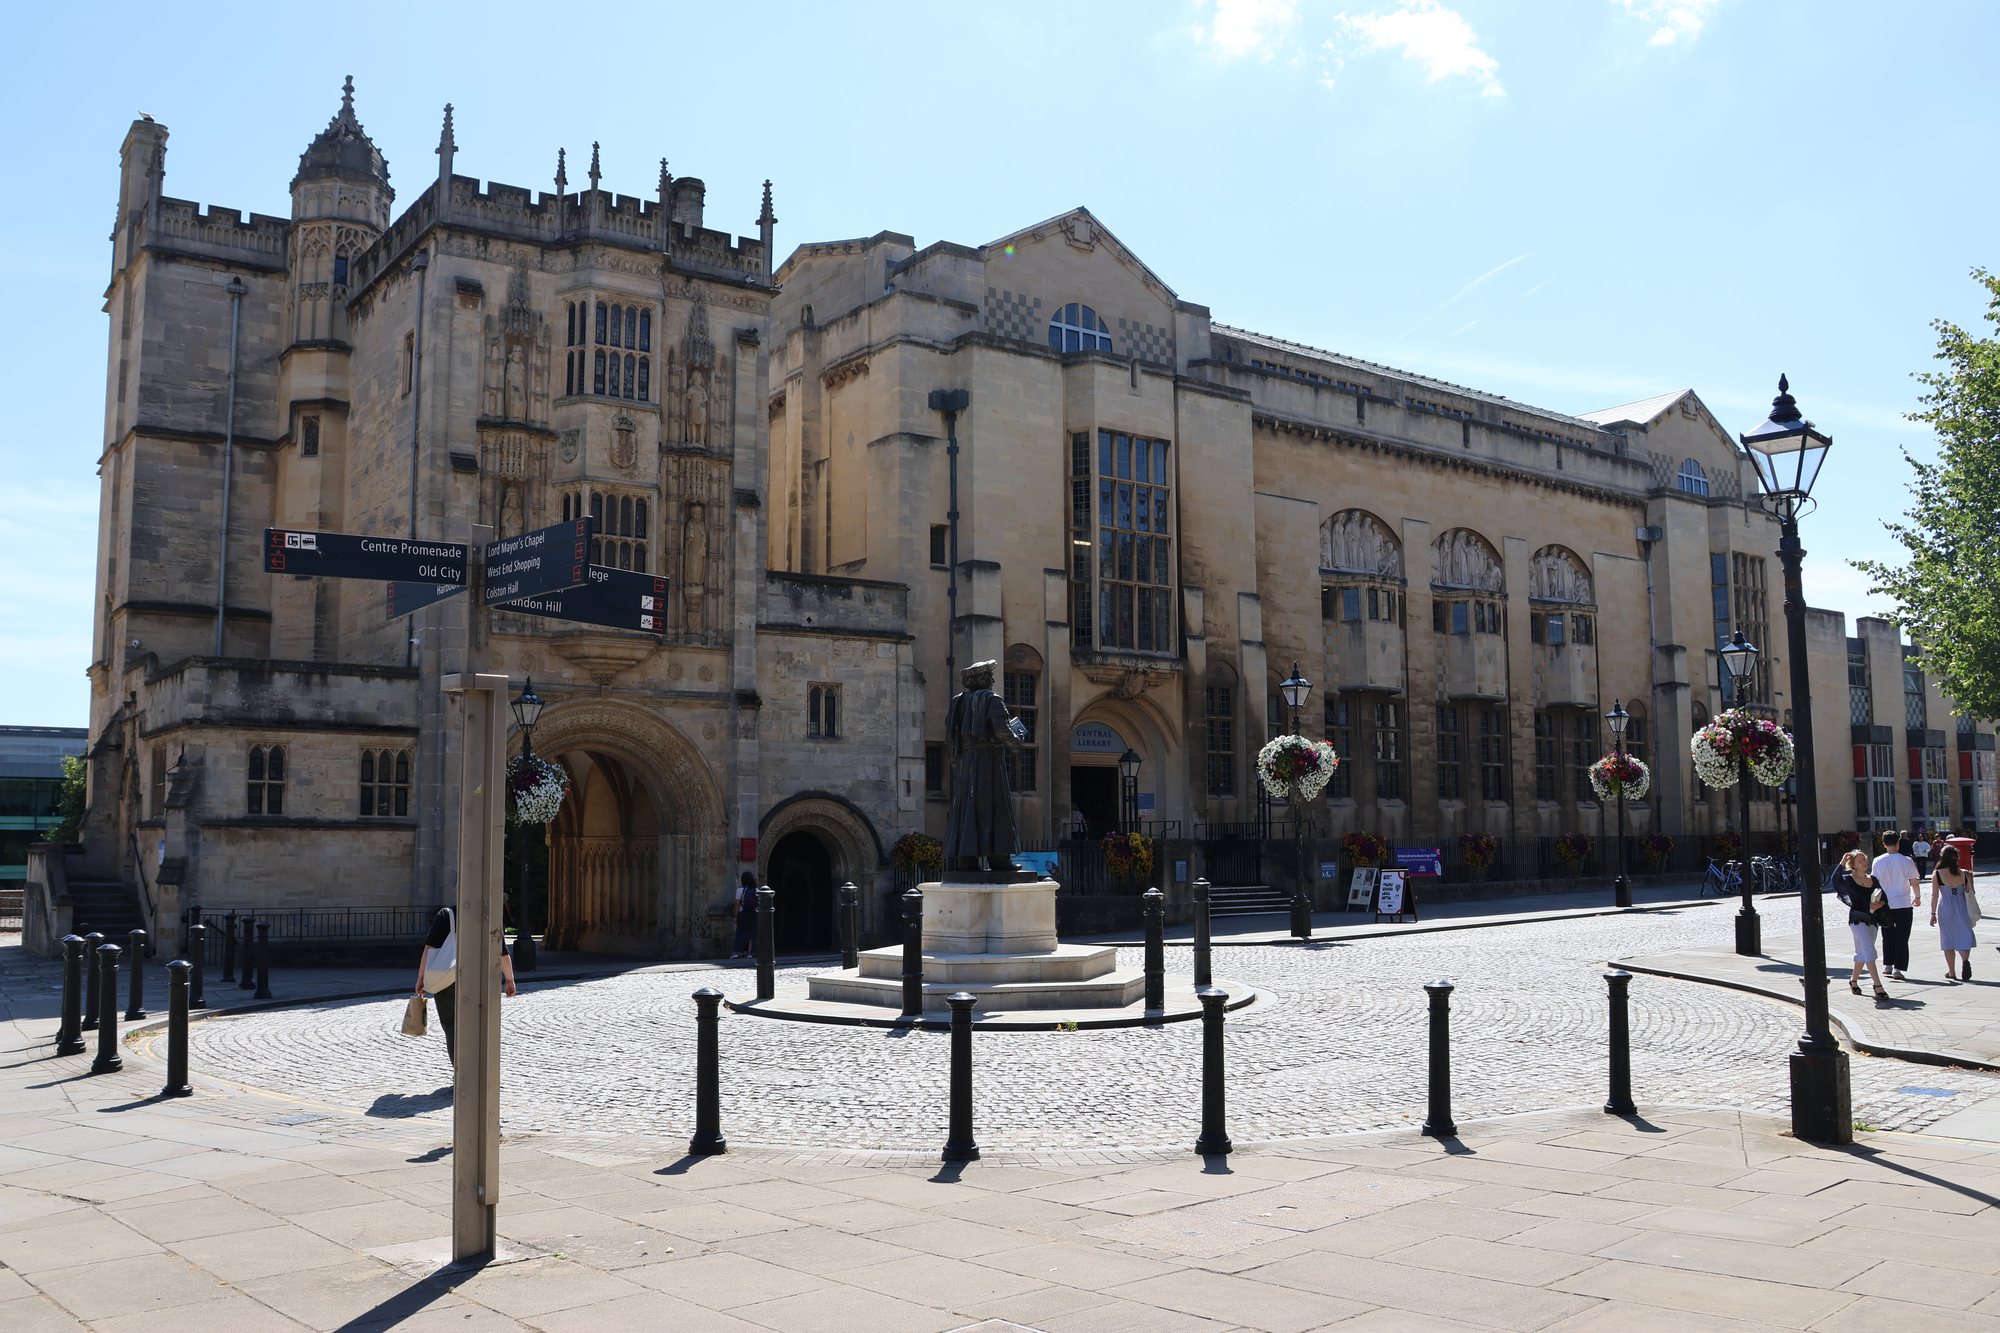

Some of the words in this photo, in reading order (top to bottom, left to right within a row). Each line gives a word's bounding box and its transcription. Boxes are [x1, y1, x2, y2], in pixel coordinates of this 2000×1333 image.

[361, 539, 398, 554] Centre
[401, 543, 462, 558] Promenade
[488, 543, 500, 557] Lord
[501, 537, 523, 555] Mayor's
[524, 531, 545, 548] Chapel
[418, 565, 437, 578] Old
[440, 567, 461, 582] City
[488, 566, 501, 578] West
[502, 561, 513, 575] End
[514, 556, 541, 572] Shopping
[588, 567, 609, 582] lege
[486, 586, 507, 600] Colston
[507, 580, 519, 594] Hall
[507, 597, 543, 610] andon
[545, 600, 562, 613] Hill
[1076, 729, 1112, 738] CENTRAL
